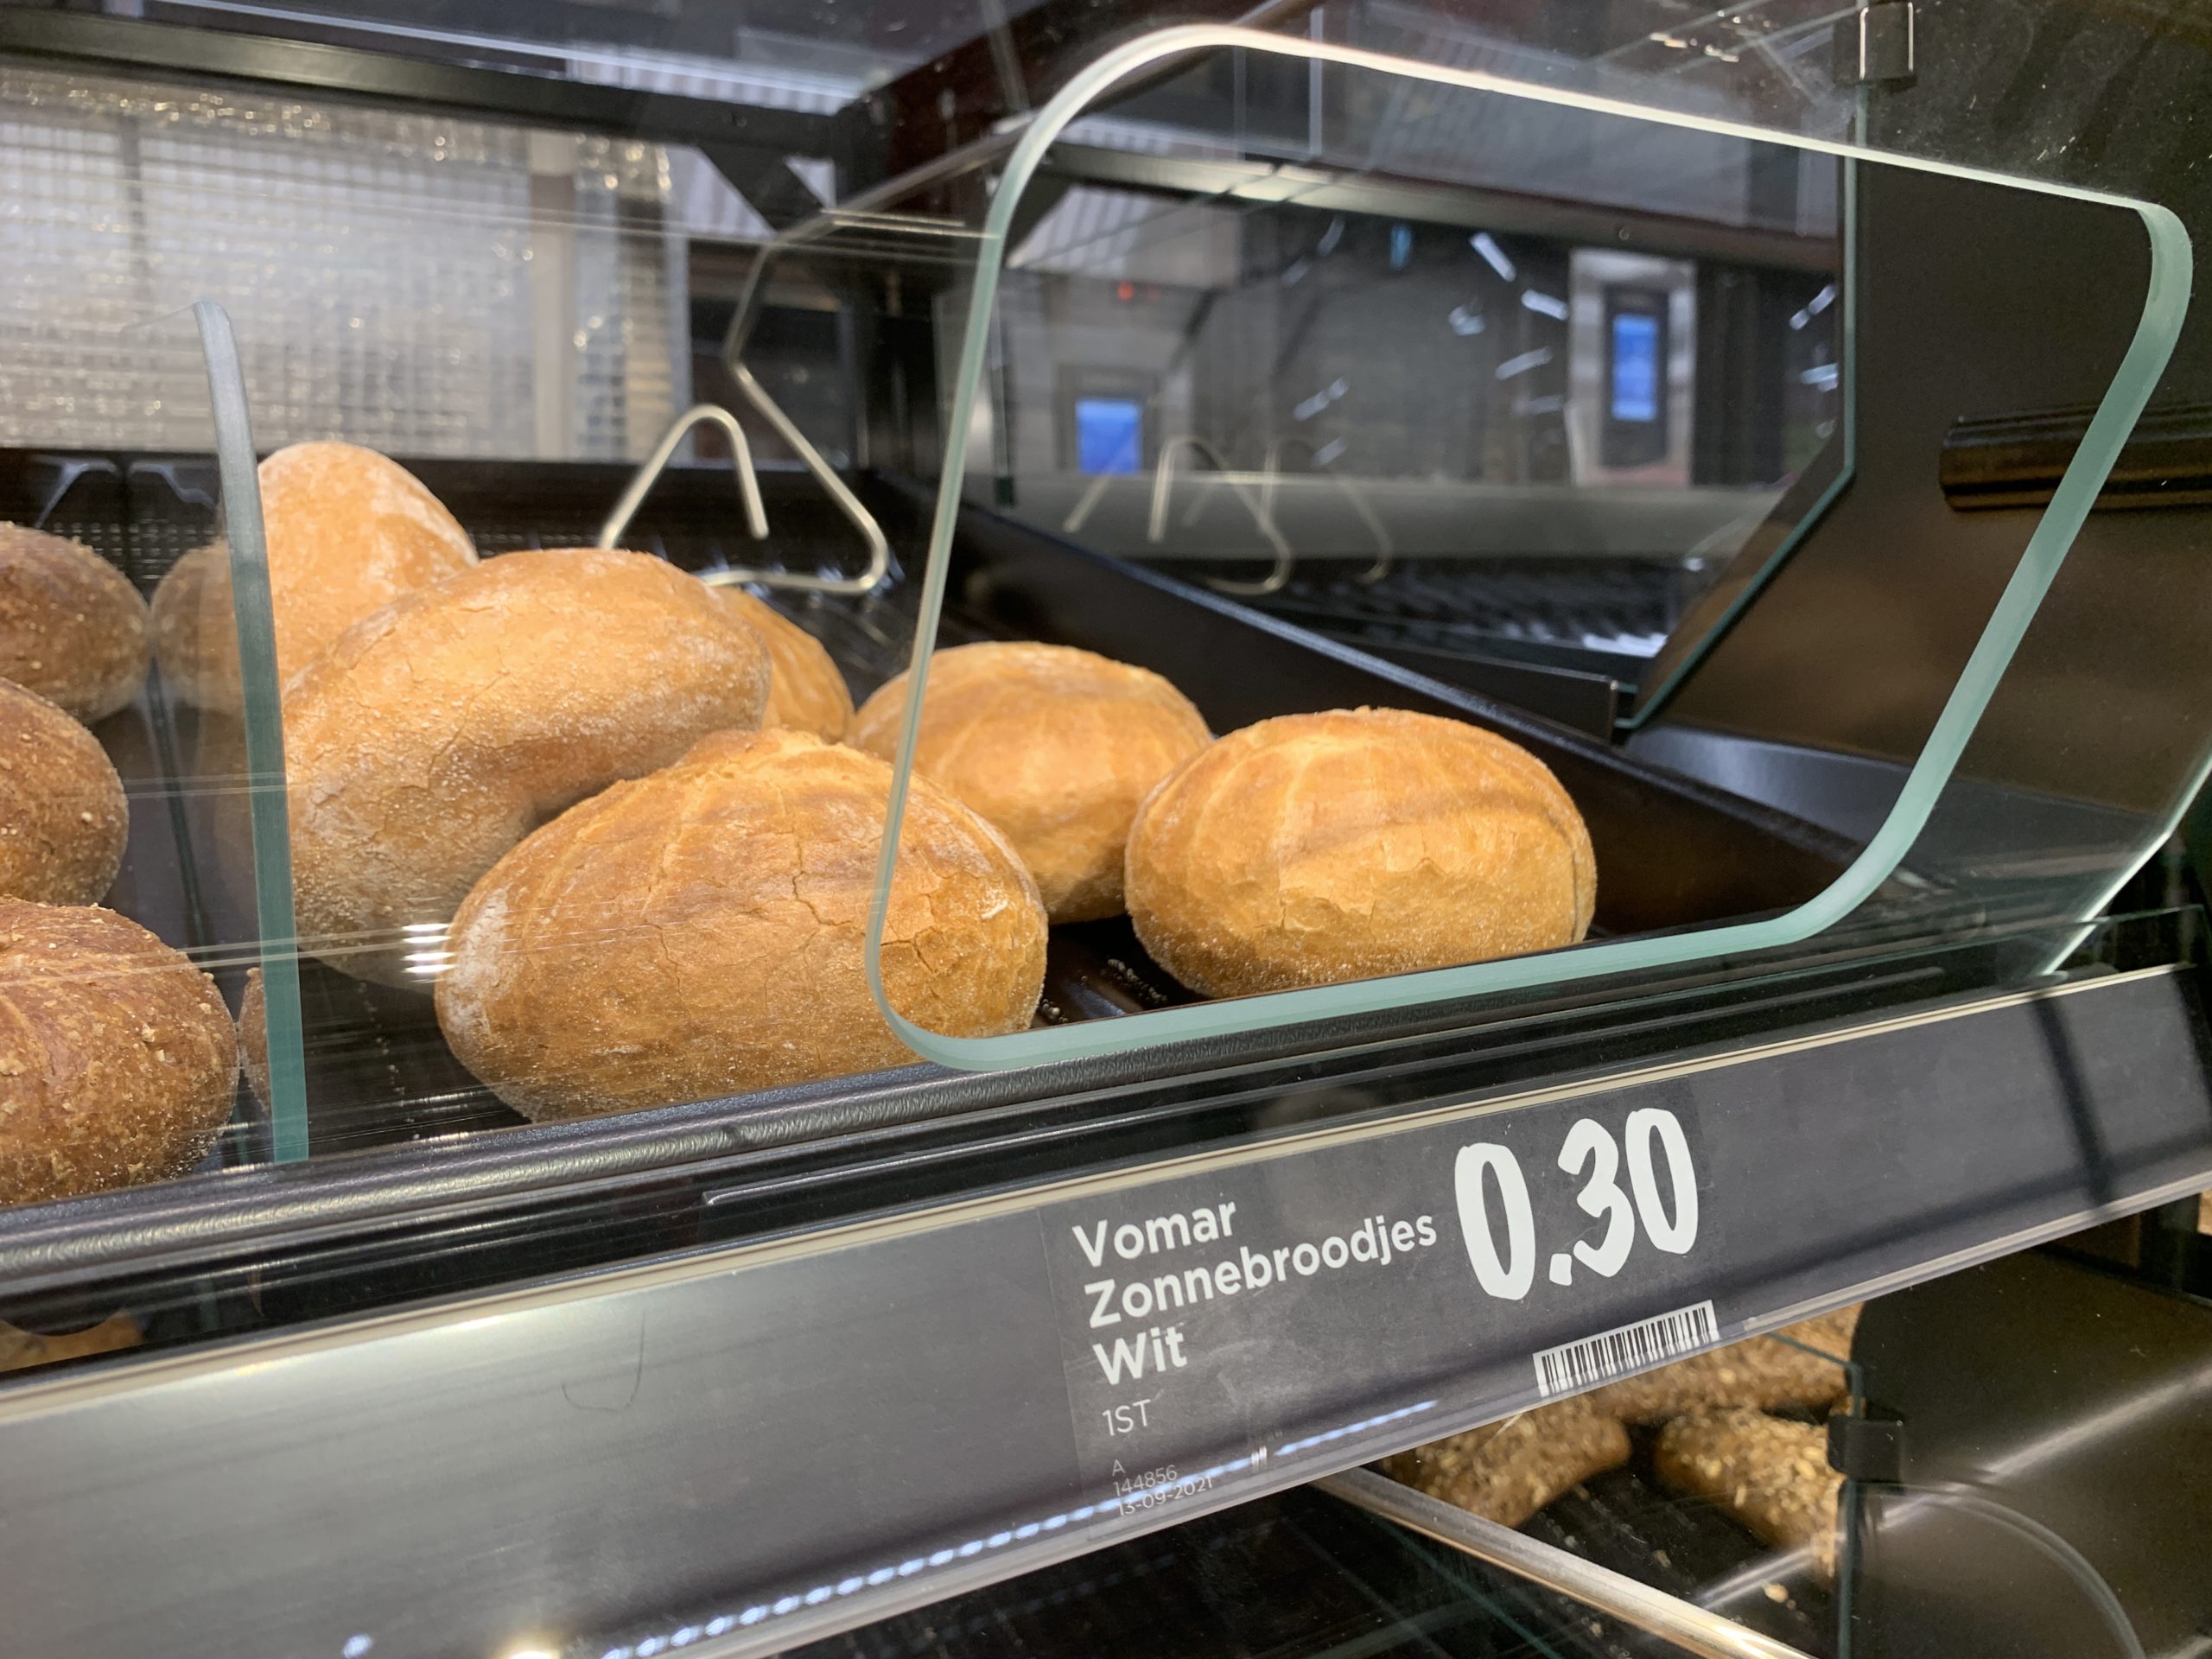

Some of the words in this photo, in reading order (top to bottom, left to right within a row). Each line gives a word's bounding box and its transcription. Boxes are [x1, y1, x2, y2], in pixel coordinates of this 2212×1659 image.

[1453, 1108, 1699, 1300] 0.30
[1072, 1201, 1236, 1267] Vomar
[1084, 1215, 1437, 1327] Zonnebroodjes
[1093, 1325, 1188, 1385] Wit
[1102, 1398, 1152, 1436] 1ST
[1111, 1459, 1126, 1478] A
[1112, 1465, 1178, 1497] 144856
[1117, 1476, 1214, 1516] 13-09-2021
